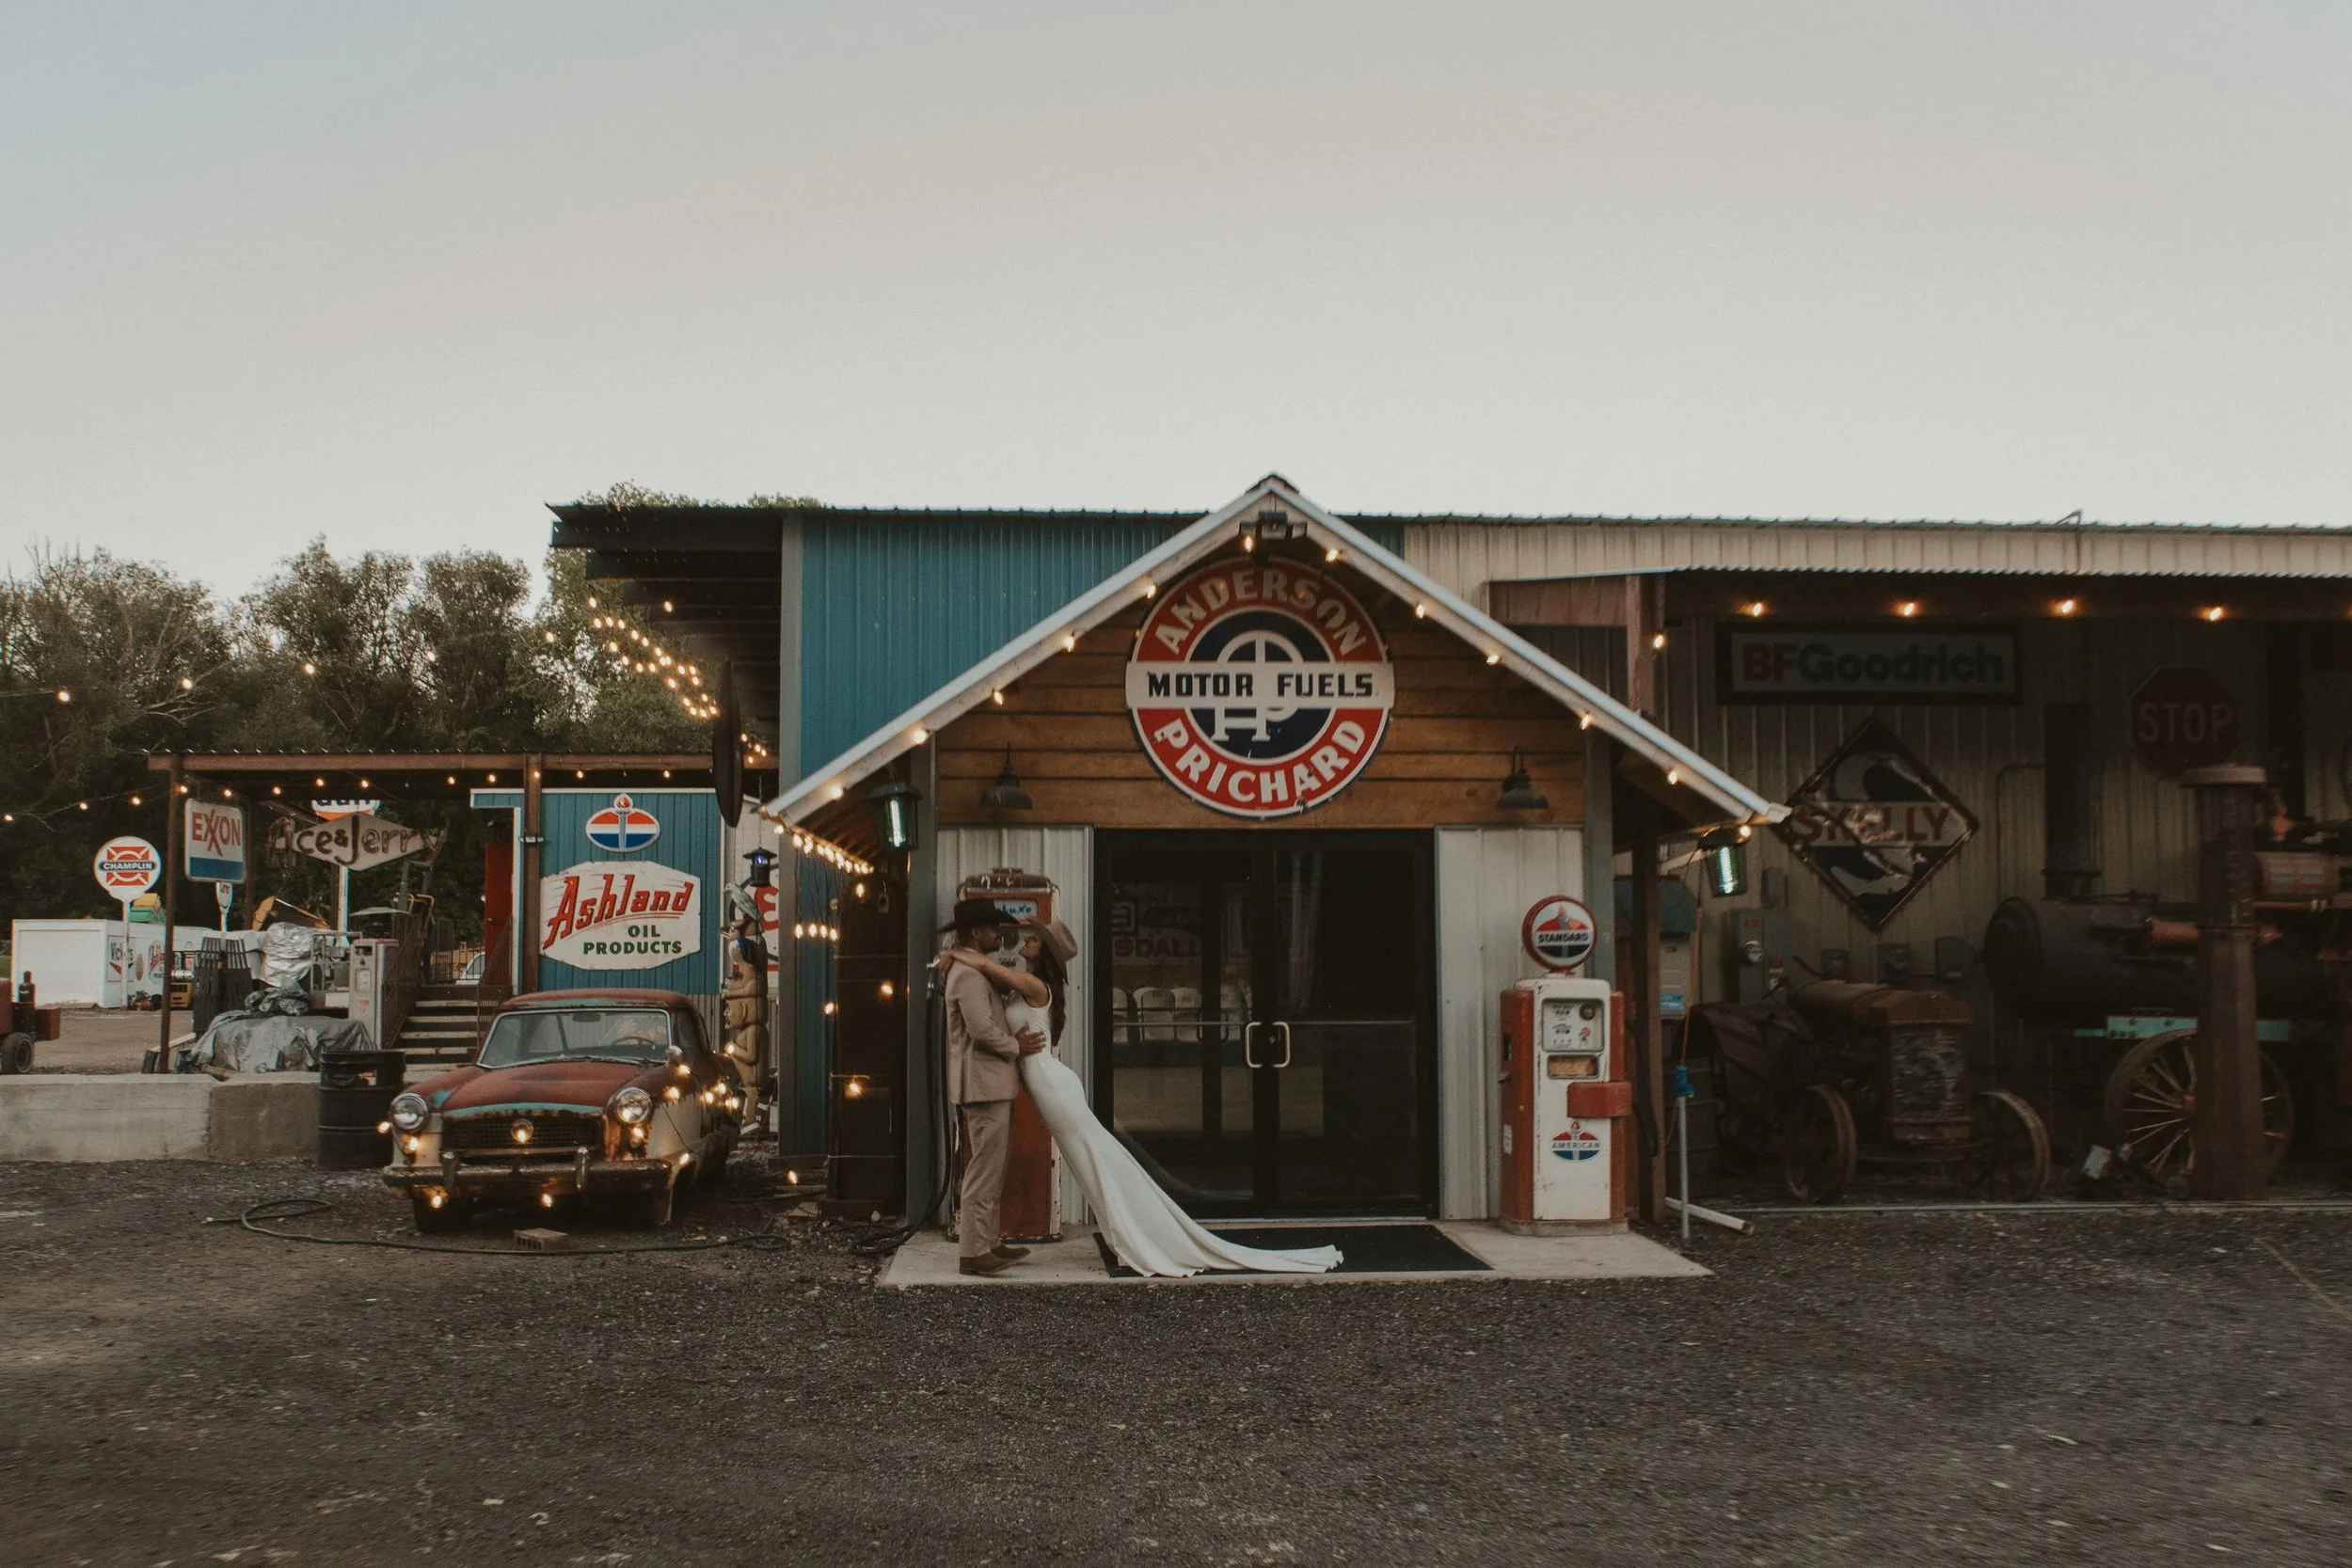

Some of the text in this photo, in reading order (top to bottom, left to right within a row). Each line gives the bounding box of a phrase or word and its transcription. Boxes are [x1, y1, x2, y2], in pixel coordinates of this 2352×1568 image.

[1154, 568, 1367, 657] ANDERSON
[1148, 672, 1374, 698] MOTOR FUELS
[2137, 701, 2233, 743] STOP
[1153, 718, 1366, 804] PRICHARD
[191, 809, 242, 857] EXXON
[103, 862, 153, 871] CHAMPLIN
[542, 873, 694, 950] Ashland
[627, 925, 661, 938] OIL
[1538, 932, 1589, 943] STANDARD
[582, 941, 682, 955] PRODUCTS
[1551, 1141, 1601, 1149] AMERICAN
